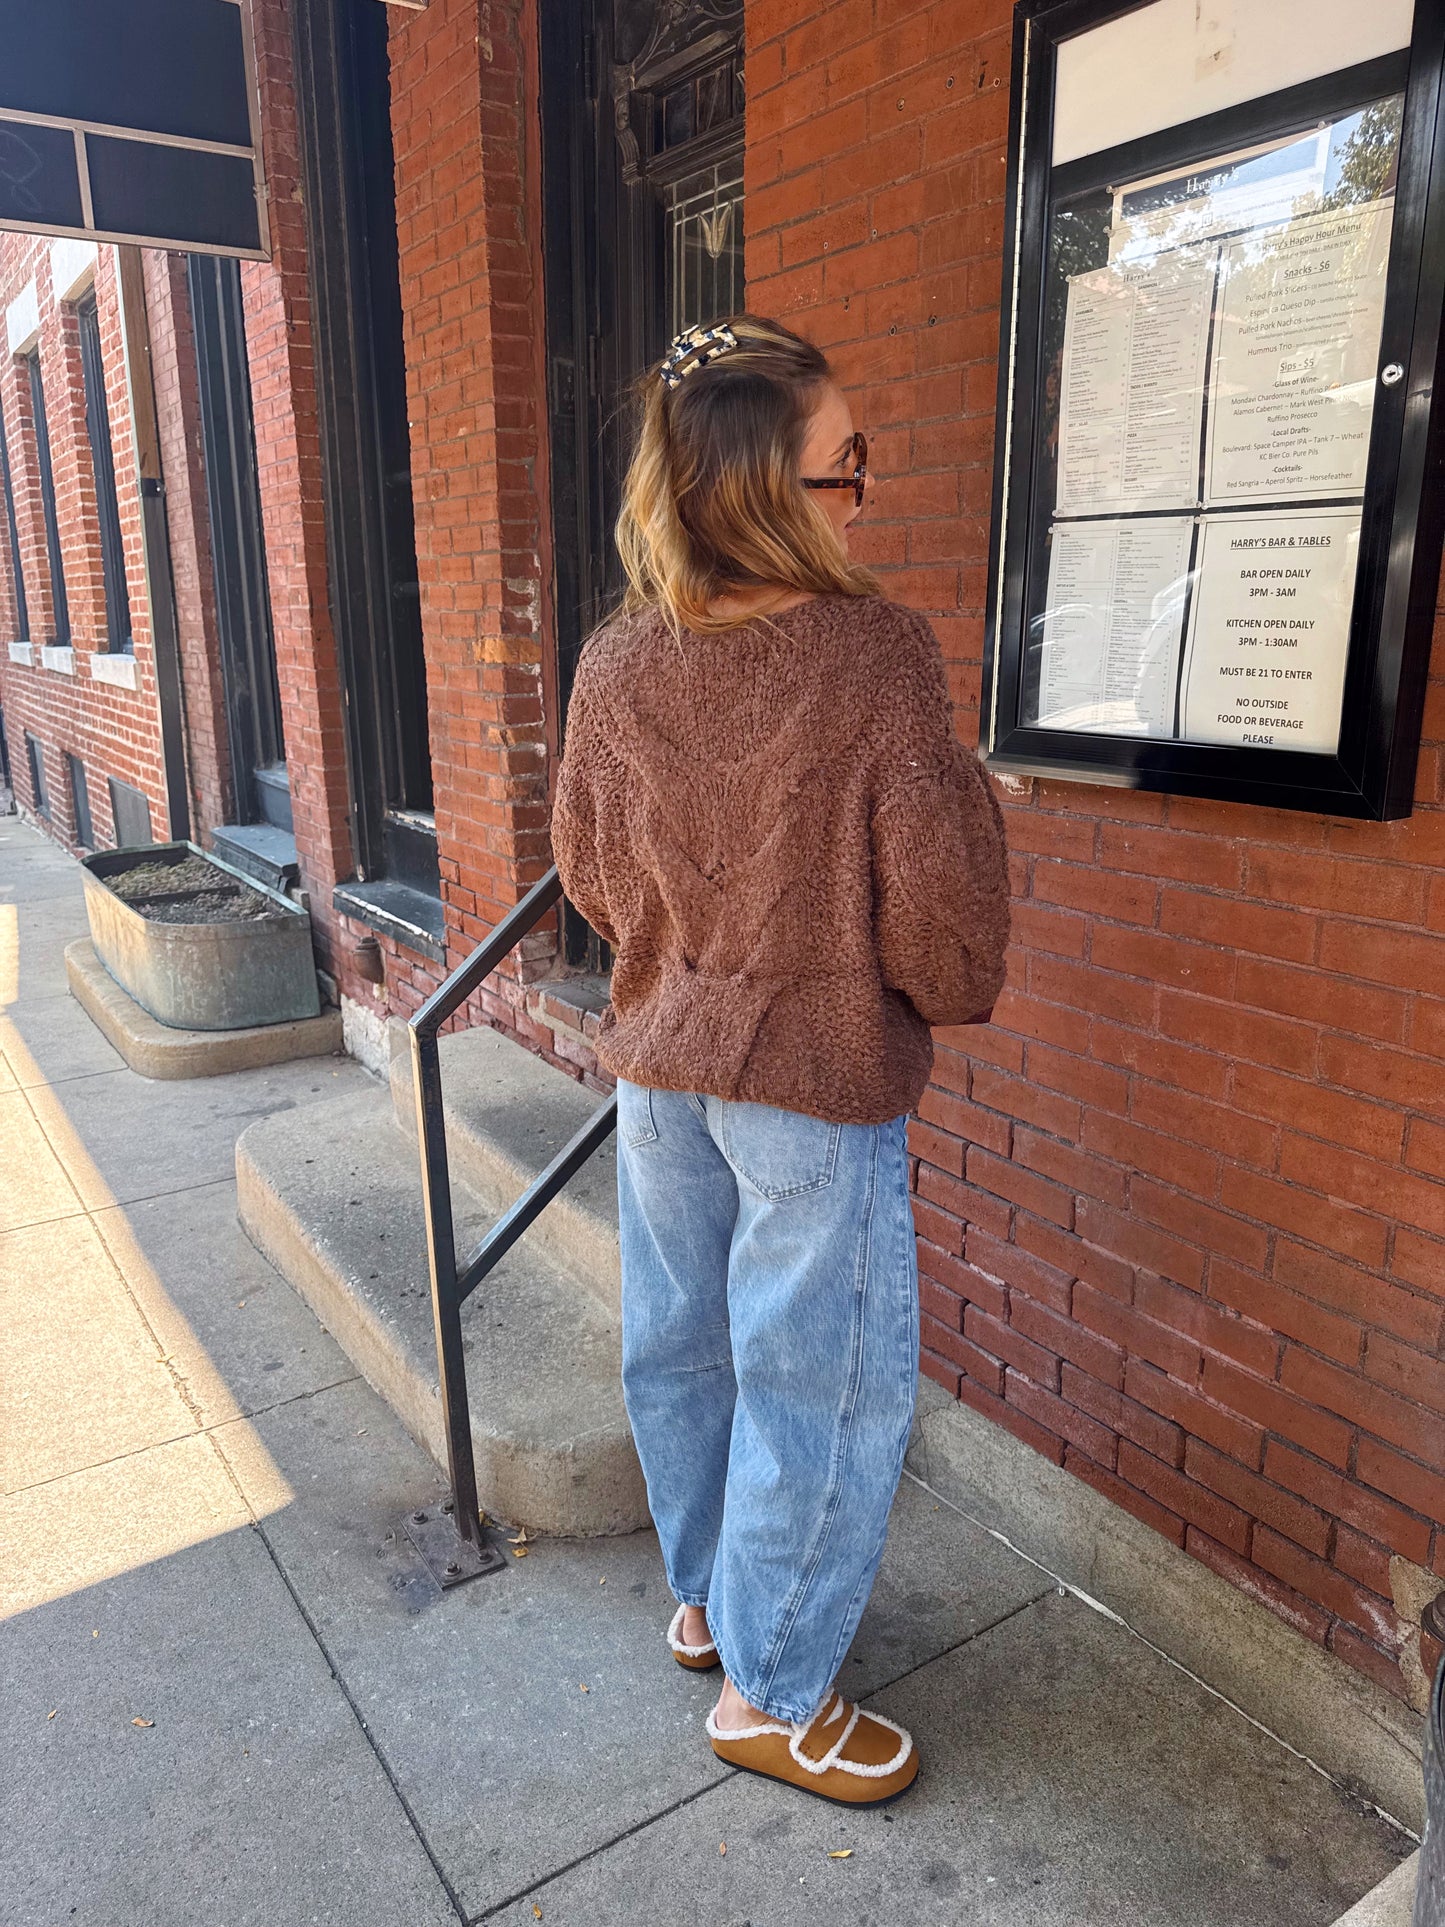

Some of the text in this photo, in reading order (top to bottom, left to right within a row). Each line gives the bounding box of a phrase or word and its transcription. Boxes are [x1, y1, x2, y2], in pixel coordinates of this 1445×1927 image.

[1290, 234, 1313, 246] Happy
[1316, 229, 1335, 239] Hour
[1337, 223, 1361, 234] Menu
[1284, 265, 1311, 278] Snacks
[1319, 260, 1330, 272] $6
[1267, 289, 1282, 298] Pork
[1281, 301, 1302, 311] Queso
[1304, 298, 1316, 308] Dip
[1238, 323, 1259, 335] Pulled
[1260, 321, 1275, 331] Pork
[1248, 346, 1277, 356] Hummus
[1279, 343, 1292, 352] Trio
[1280, 361, 1296, 372] Sips
[1304, 358, 1314, 368] $5
[1231, 396, 1256, 405] Mondavi
[1258, 392, 1293, 402] Chardonnay
[1300, 387, 1323, 395] Ruffino
[1233, 408, 1254, 416] Alamos
[1256, 404, 1283, 413] Cabernet
[1290, 401, 1306, 409] Mark
[1308, 398, 1323, 406] West
[1267, 411, 1318, 423] Ruffino Prosecco
[1254, 442, 1271, 451] Space
[1272, 439, 1296, 449] Camper
[1314, 436, 1328, 444] Tank
[1330, 434, 1334, 442] 7
[1341, 431, 1364, 440] Wheat
[1238, 480, 1259, 488] Sangria
[1286, 476, 1303, 485] Spritz
[1310, 472, 1352, 480] Horsefeather
[1231, 536, 1331, 548] HARRY'S BAR & TABLES
[1240, 569, 1311, 578] BAR OPEN DAILY
[1249, 588, 1268, 597] 3PM
[1275, 588, 1296, 597] 3AM
[1226, 619, 1315, 629] KITCHEN OPEN DAILY
[1238, 637, 1257, 646] 3PM
[1264, 638, 1298, 647] 1:30AM
[1220, 667, 1312, 680] MUST BE 21 TO ENTER
[1236, 698, 1288, 710] NO OUTSIDE
[1217, 715, 1304, 729] FOOD OR BEVERAGE
[1243, 734, 1274, 744] PLEASE
